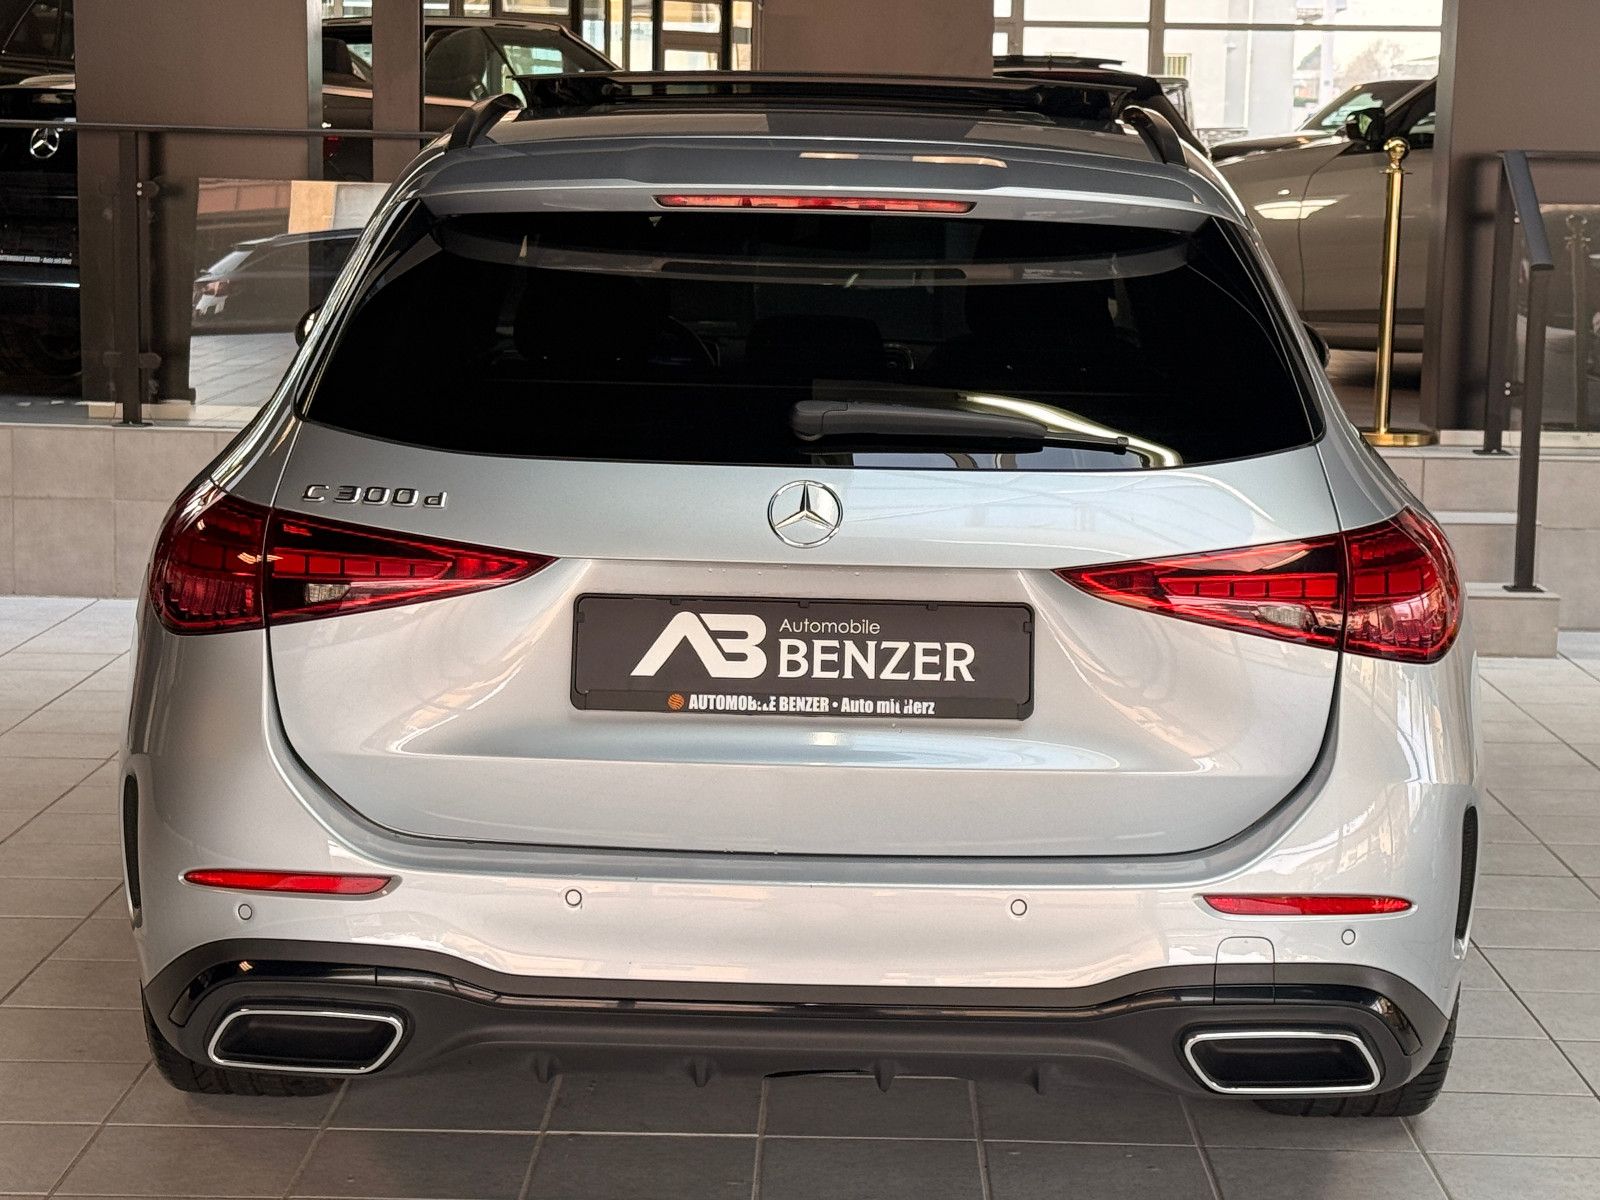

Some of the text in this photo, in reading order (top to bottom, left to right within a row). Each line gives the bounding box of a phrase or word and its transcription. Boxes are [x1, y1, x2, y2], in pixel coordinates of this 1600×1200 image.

[779, 618, 881, 635] Automobile
[630, 611, 768, 679] AB
[778, 638, 976, 682] BENZER
[779, 696, 830, 712] BENZER
[840, 697, 874, 713] Auto
[903, 699, 936, 715] Herz
